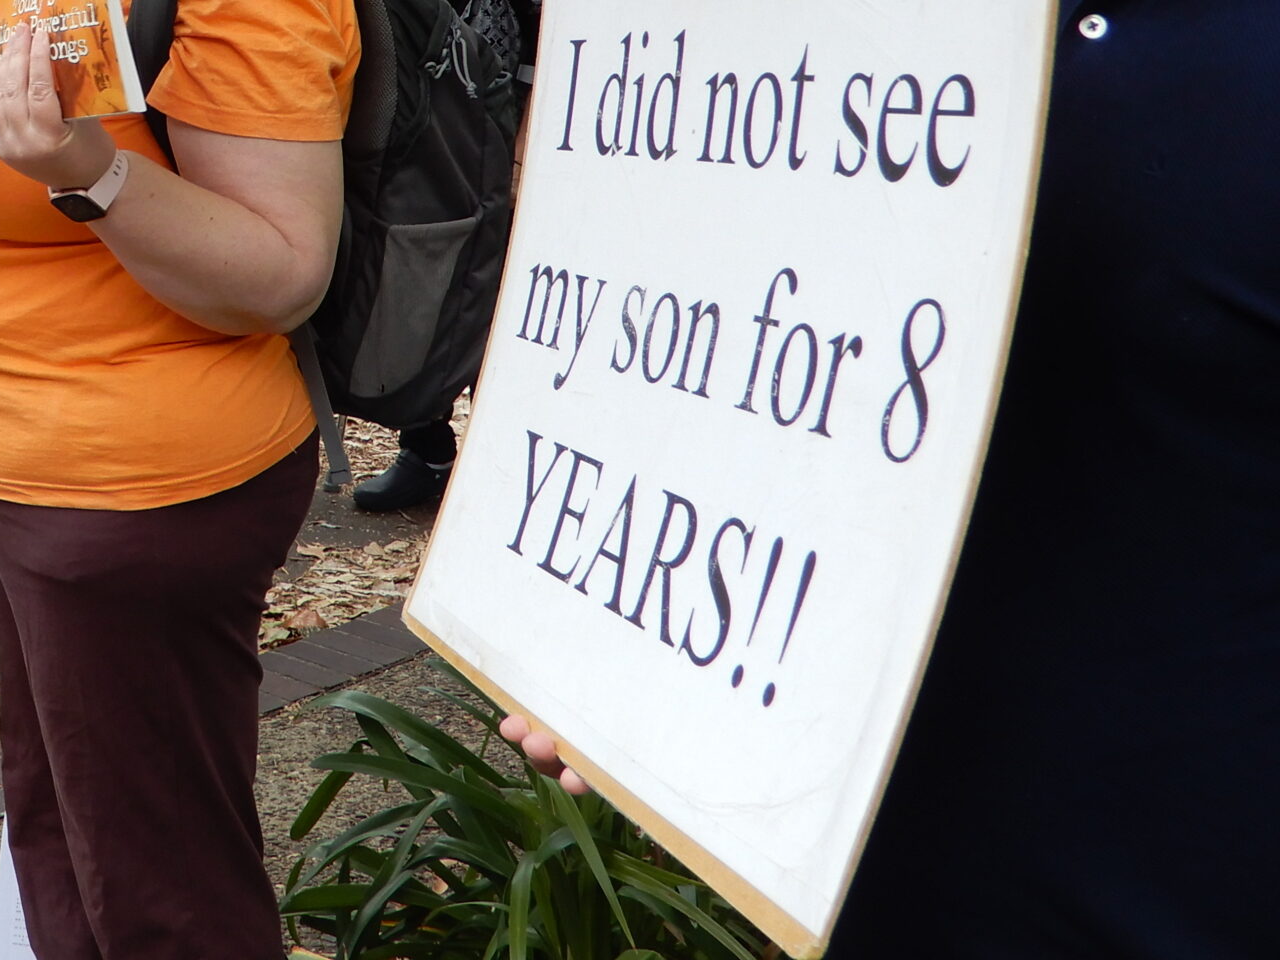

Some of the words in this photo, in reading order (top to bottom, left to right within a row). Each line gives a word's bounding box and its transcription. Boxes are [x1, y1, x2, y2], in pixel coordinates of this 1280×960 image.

[30, 3, 100, 35] Powerful
[49, 38, 89, 64] ongs
[557, 39, 587, 152] I
[596, 28, 686, 161] did
[697, 43, 816, 170] not
[833, 71, 976, 188] see
[516, 261, 606, 392] my
[610, 284, 722, 399] son
[734, 266, 863, 439] for
[881, 297, 947, 465] 8
[506, 429, 818, 708] YEARS!!
